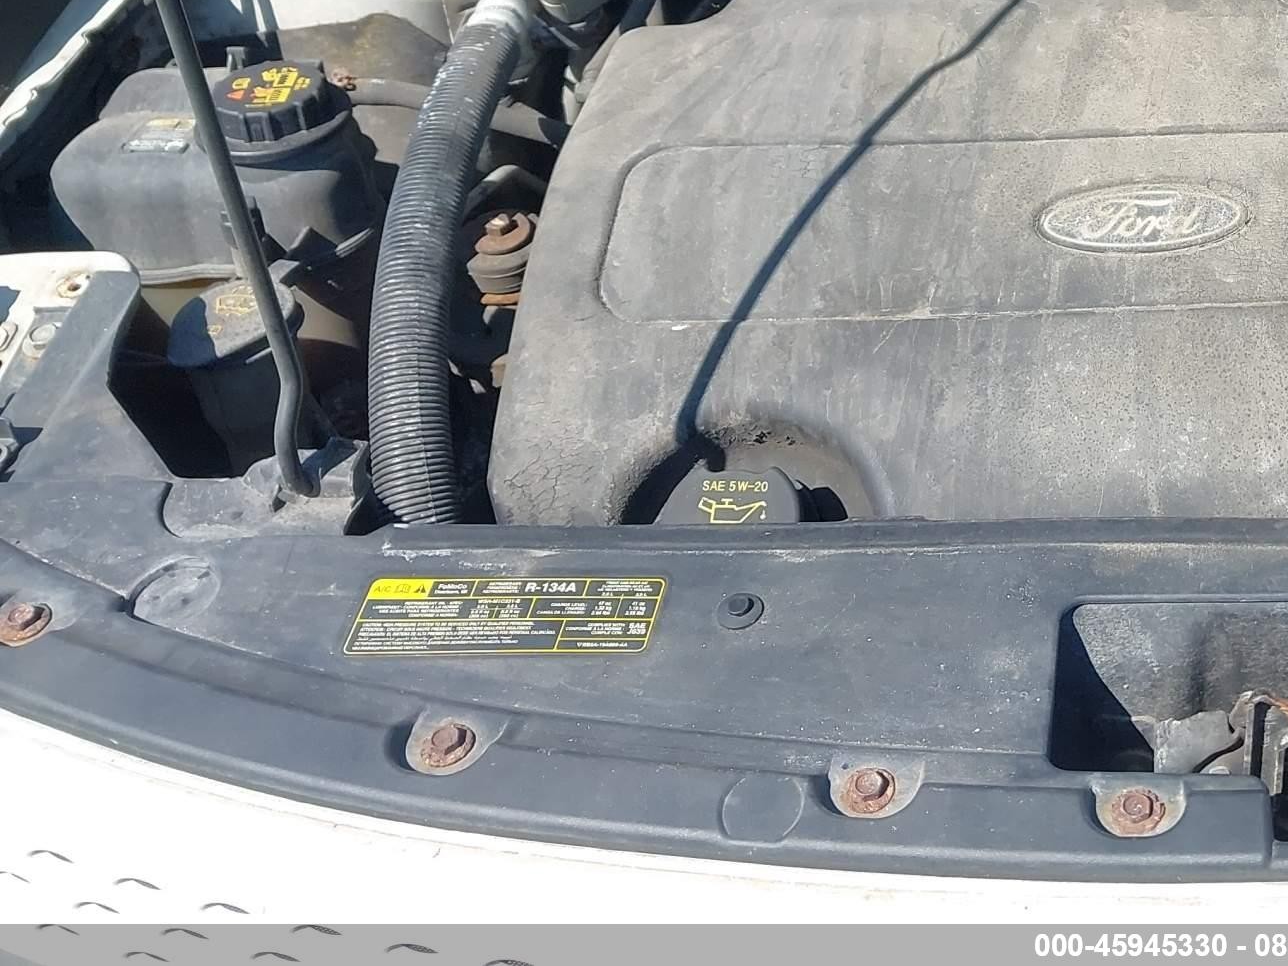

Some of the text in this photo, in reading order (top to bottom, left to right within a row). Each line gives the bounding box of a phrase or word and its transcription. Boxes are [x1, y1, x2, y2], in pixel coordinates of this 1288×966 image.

[1082, 198, 1201, 240] Ford
[702, 480, 769, 492] SAE 5W-20
[373, 585, 392, 593] A/C
[524, 582, 577, 593] R-134A
